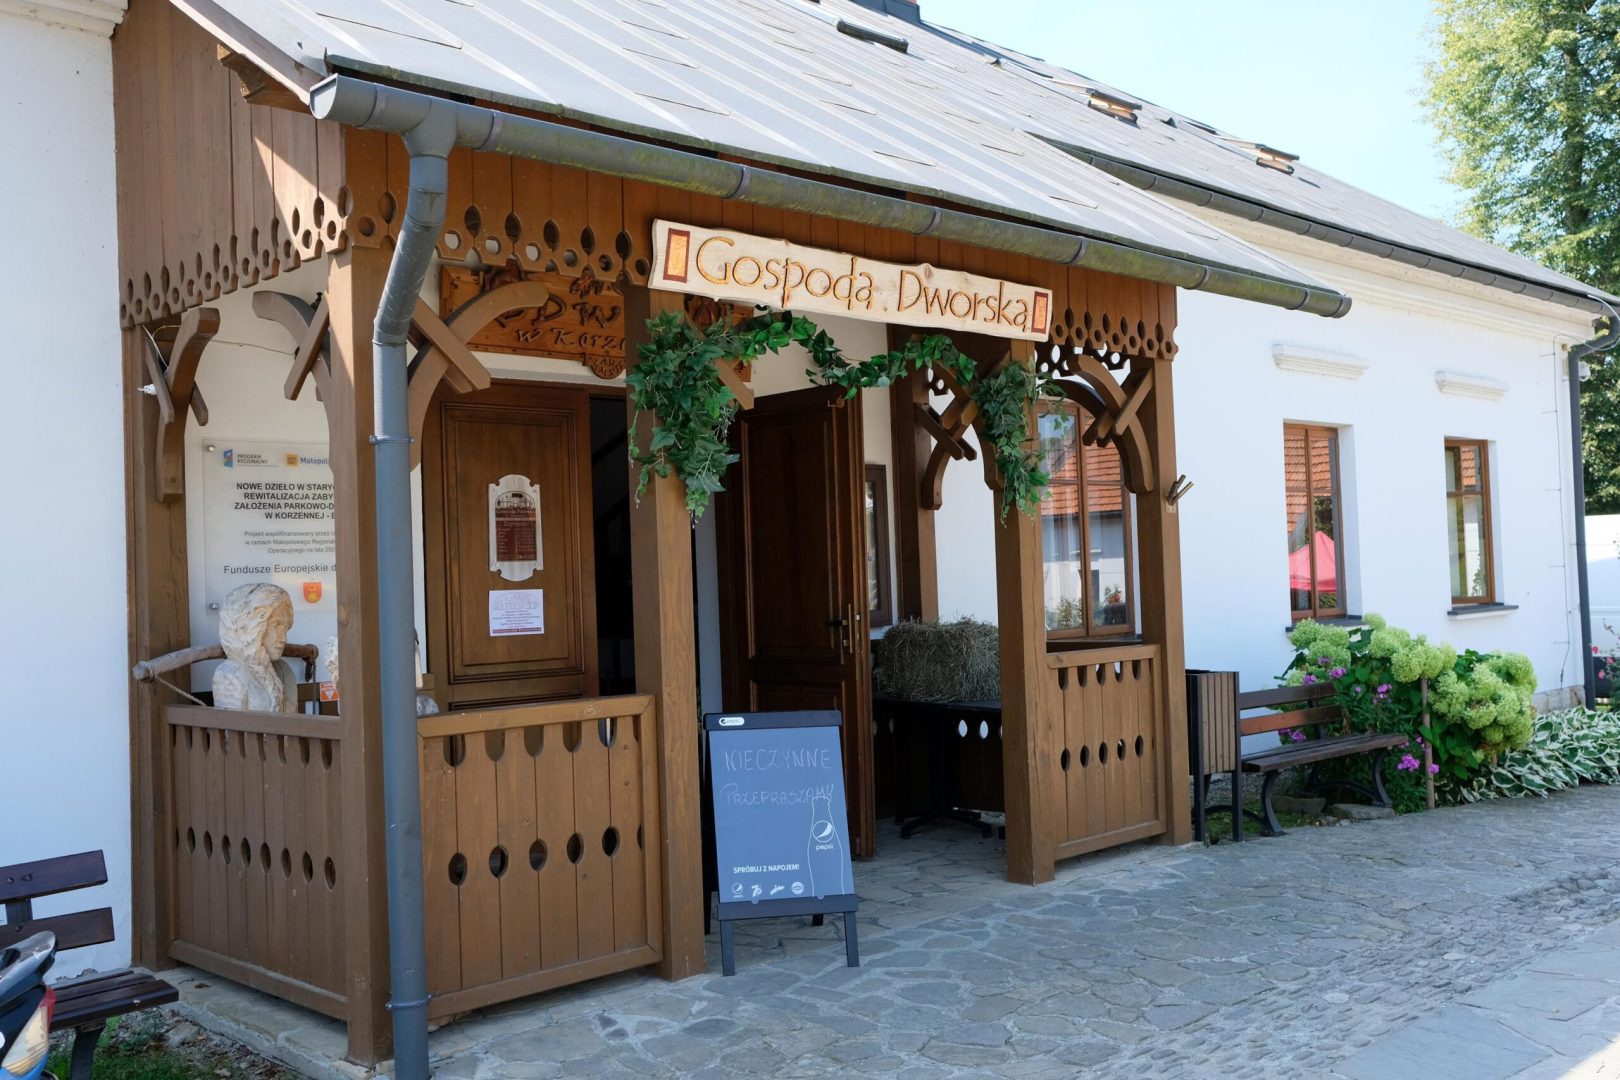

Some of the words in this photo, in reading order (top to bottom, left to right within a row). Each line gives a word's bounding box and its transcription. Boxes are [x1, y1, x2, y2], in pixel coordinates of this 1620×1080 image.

[696, 236, 874, 310] Gospoda
[898, 269, 1031, 332] Dworska
[236, 482, 262, 490] NOWE
[265, 483, 295, 491] DZIEŁO
[297, 483, 305, 491] W
[244, 492, 310, 500] REWITALIZACJA
[234, 501, 282, 510] ZAŁOŻENIA
[275, 512, 325, 520] KORZENNEJ
[224, 565, 271, 574] Fundusze
[274, 563, 328, 574] Europejskie
[724, 748, 832, 771] NIECZYNNE
[815, 843, 834, 852] pepsi
[733, 865, 762, 874] SPRÓBUJ
[768, 863, 800, 873] NAPOJEM!
